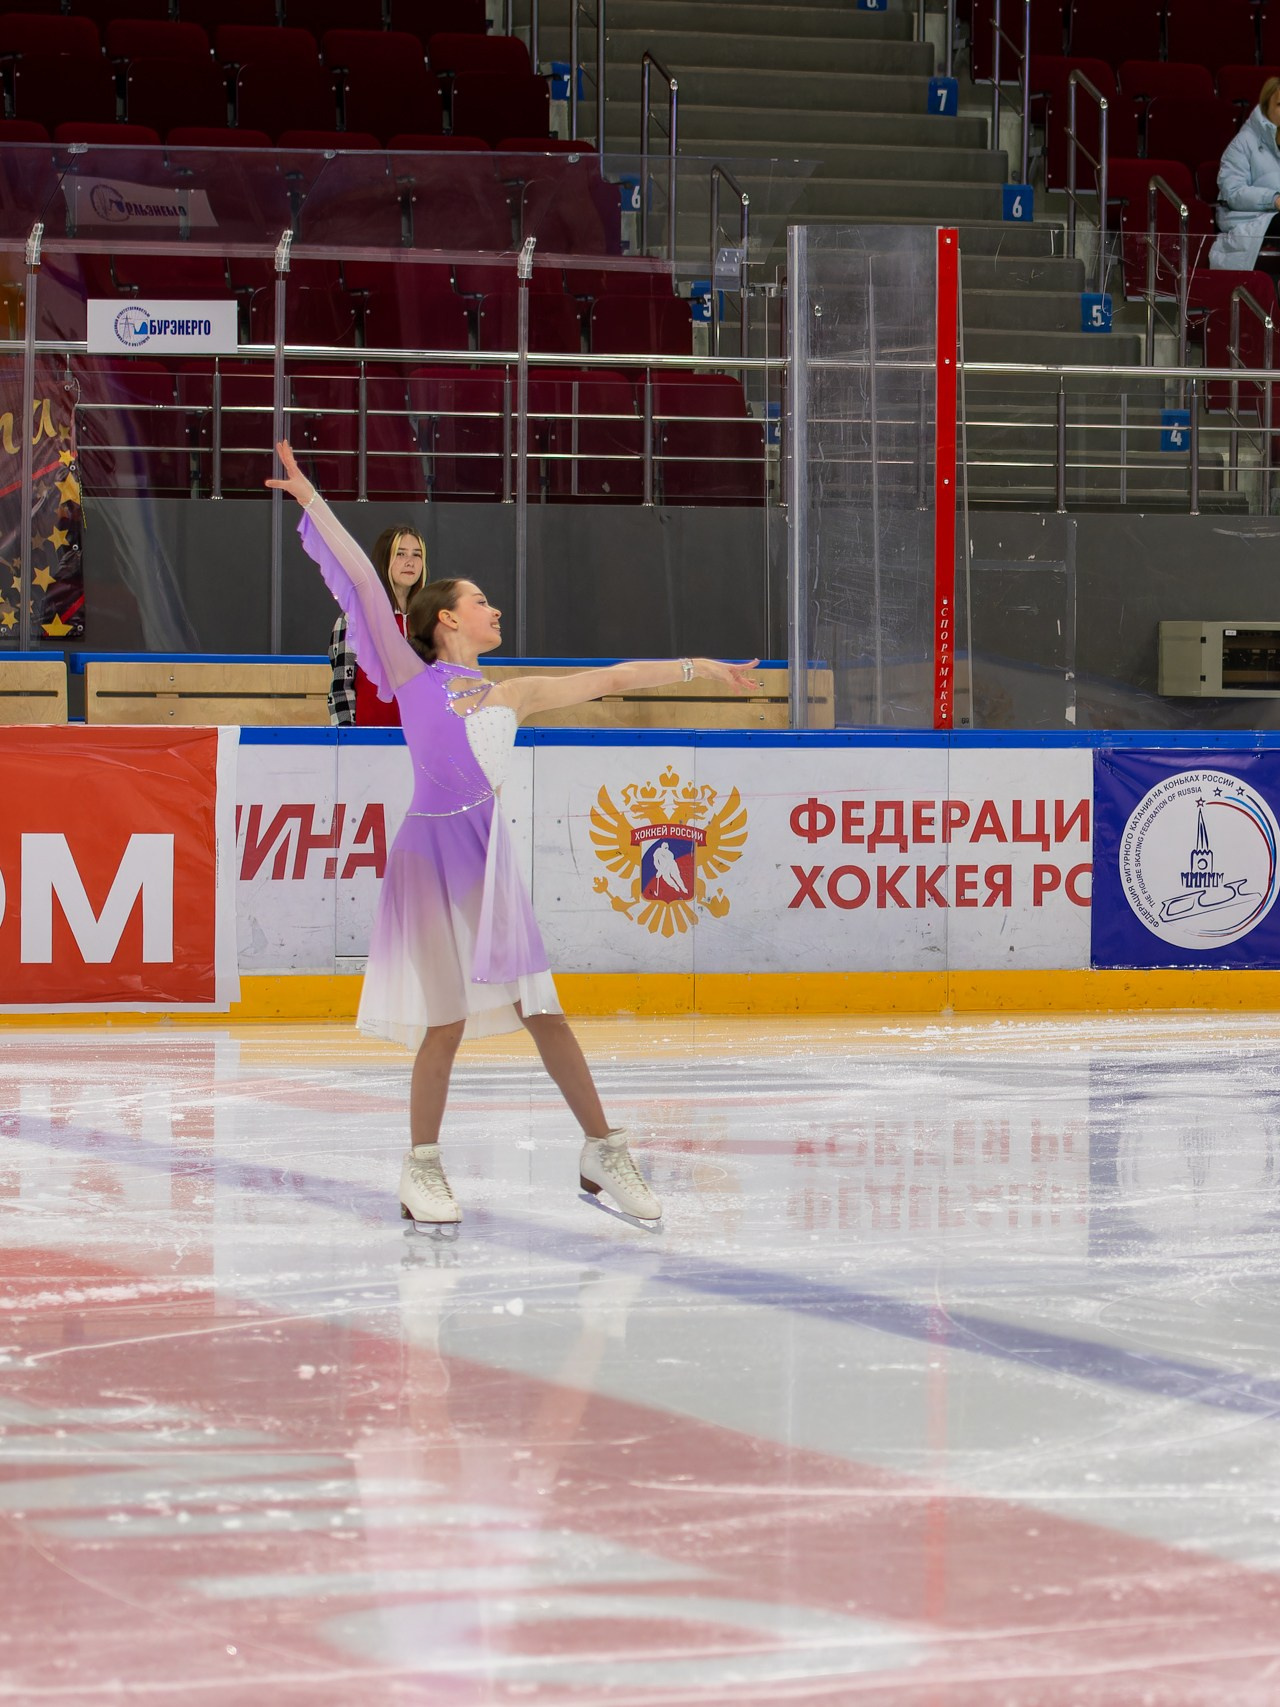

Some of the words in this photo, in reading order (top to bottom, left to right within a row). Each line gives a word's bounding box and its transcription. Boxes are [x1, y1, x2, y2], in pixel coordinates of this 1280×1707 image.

[937, 89, 948, 112] 7
[631, 185, 641, 209] 6
[1012, 195, 1023, 218] 6
[149, 319, 212, 335] БУРЭНЕРГО
[1091, 305, 1103, 327] 5
[1170, 422, 1182, 446] 4
[939, 607, 949, 712] СПОРТМАКС
[1163, 774, 1200, 791] КОНЬКАХ
[1177, 786, 1202, 798] RUSSIA
[1202, 774, 1235, 788] РОССИИ
[1152, 789, 1163, 800] НА
[1167, 793, 1177, 802] OF
[789, 797, 1091, 853] ФЕДЕРАЦИ
[1129, 797, 1154, 831] КАТАНИЯ
[1140, 800, 1168, 837] FEDERATION
[634, 825, 668, 841] ХОККЕЙ
[669, 827, 703, 842] РОССИИ
[1123, 833, 1134, 883] ФИГУРНОГО
[1135, 836, 1144, 867] SKATING
[787, 864, 1012, 909] ХОККЕЯ
[1136, 869, 1148, 895] FIGURE
[1128, 885, 1160, 928] ФЕДЕРАЦИЯ
[1145, 894, 1156, 908] THE
